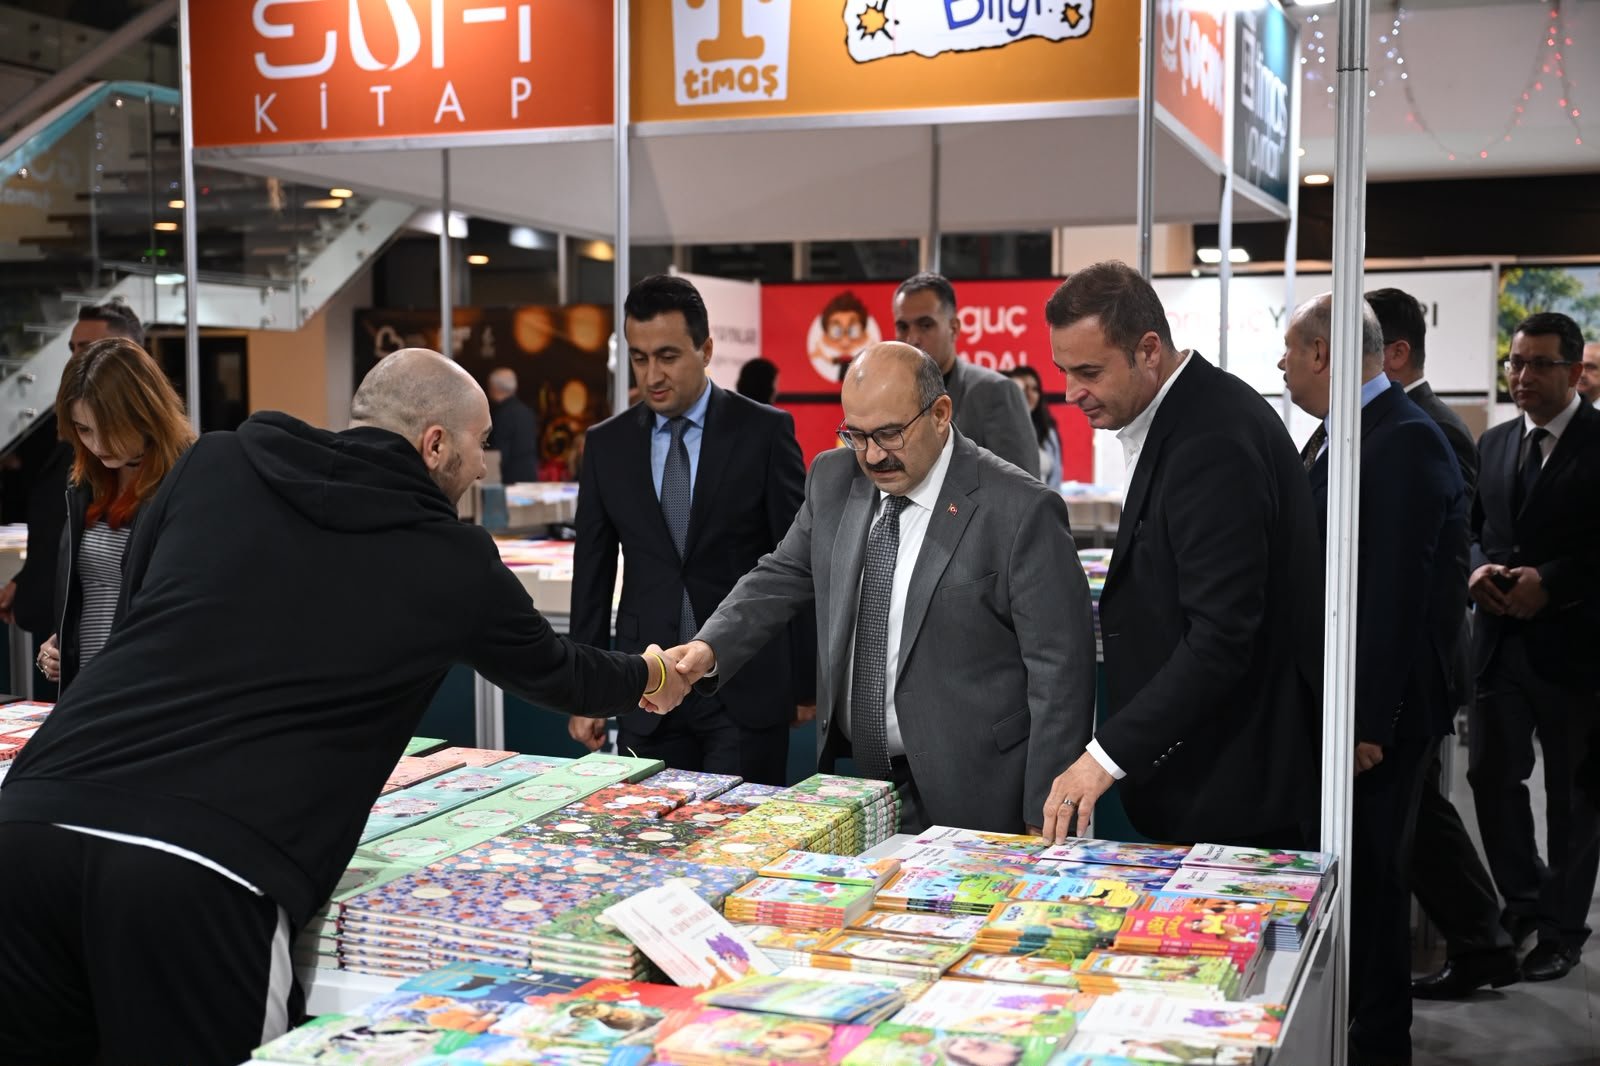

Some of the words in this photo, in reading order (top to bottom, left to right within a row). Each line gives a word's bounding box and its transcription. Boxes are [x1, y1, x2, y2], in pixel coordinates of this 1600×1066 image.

[683, 65, 779, 99] timaş
[255, 77, 532, 134] KİTAP
[957, 304, 1027, 345] guç
